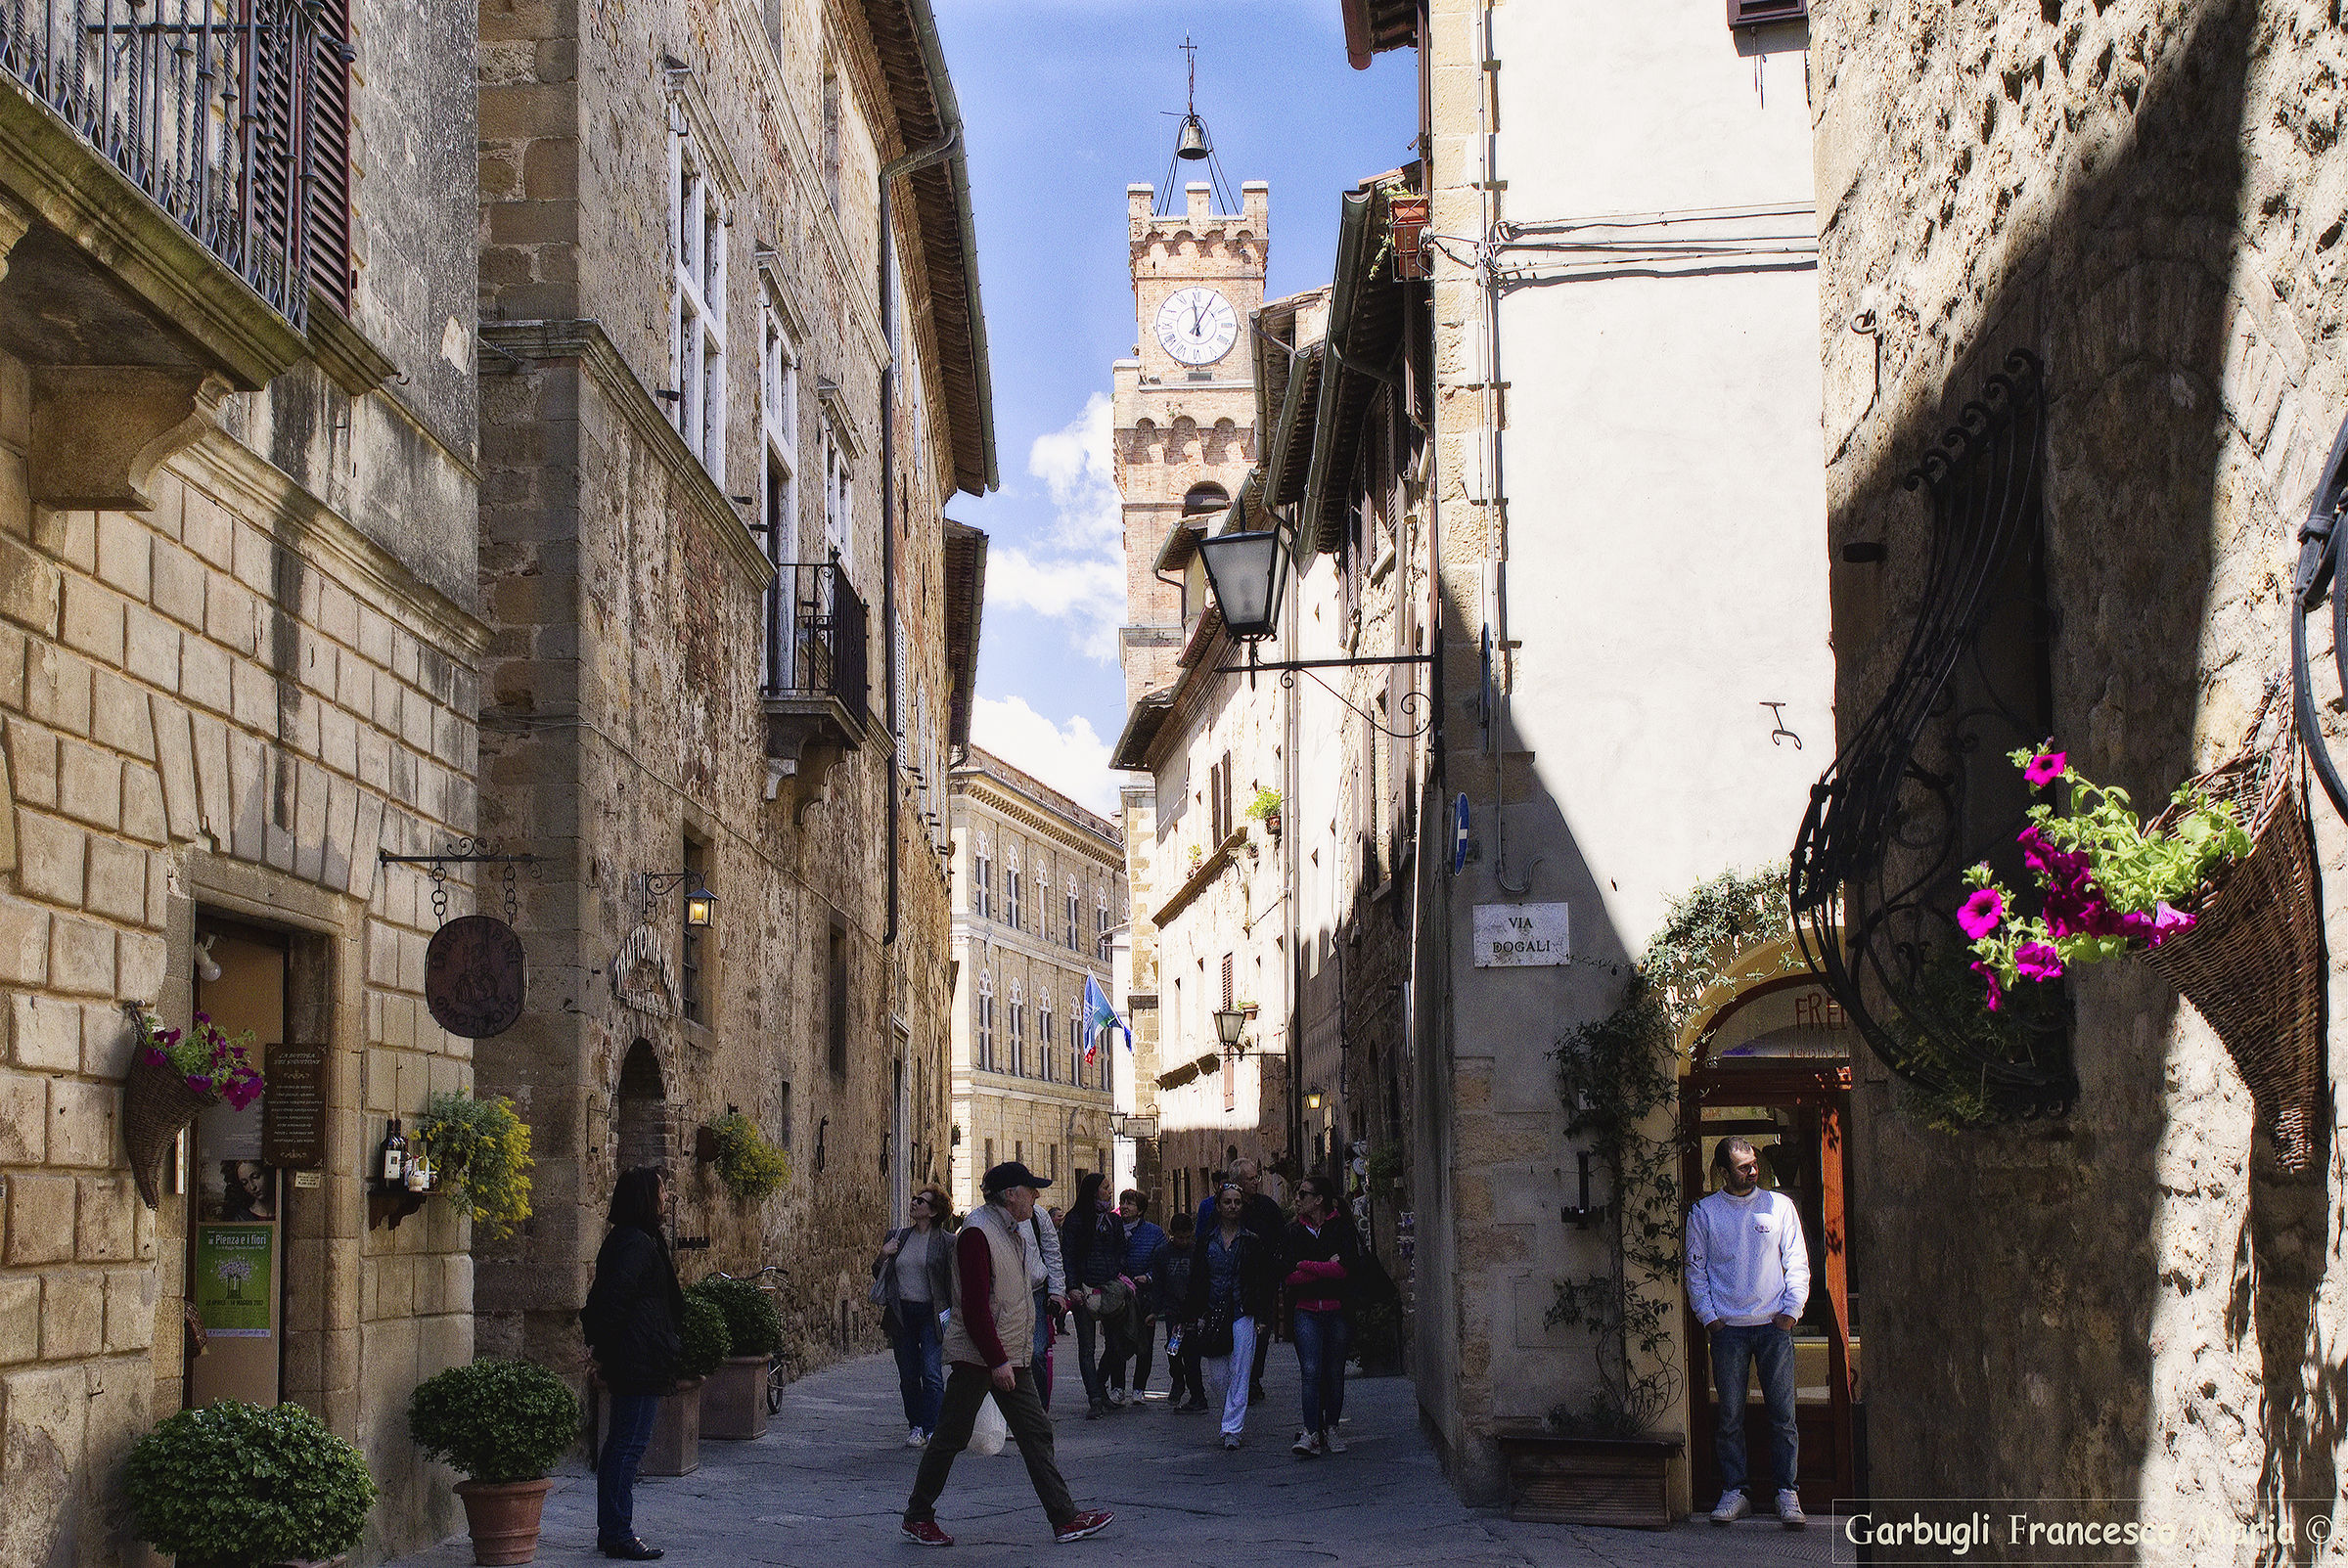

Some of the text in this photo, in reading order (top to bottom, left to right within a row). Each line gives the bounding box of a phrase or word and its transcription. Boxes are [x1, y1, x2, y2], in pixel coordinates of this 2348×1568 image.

[1508, 917, 1533, 928] VIA
[1492, 940, 1551, 953] DOGALI
[614, 924, 661, 994] TRATTORIA
[215, 1234, 240, 1245] Pienza
[240, 1236, 246, 1245] e
[250, 1233, 267, 1245] fiori
